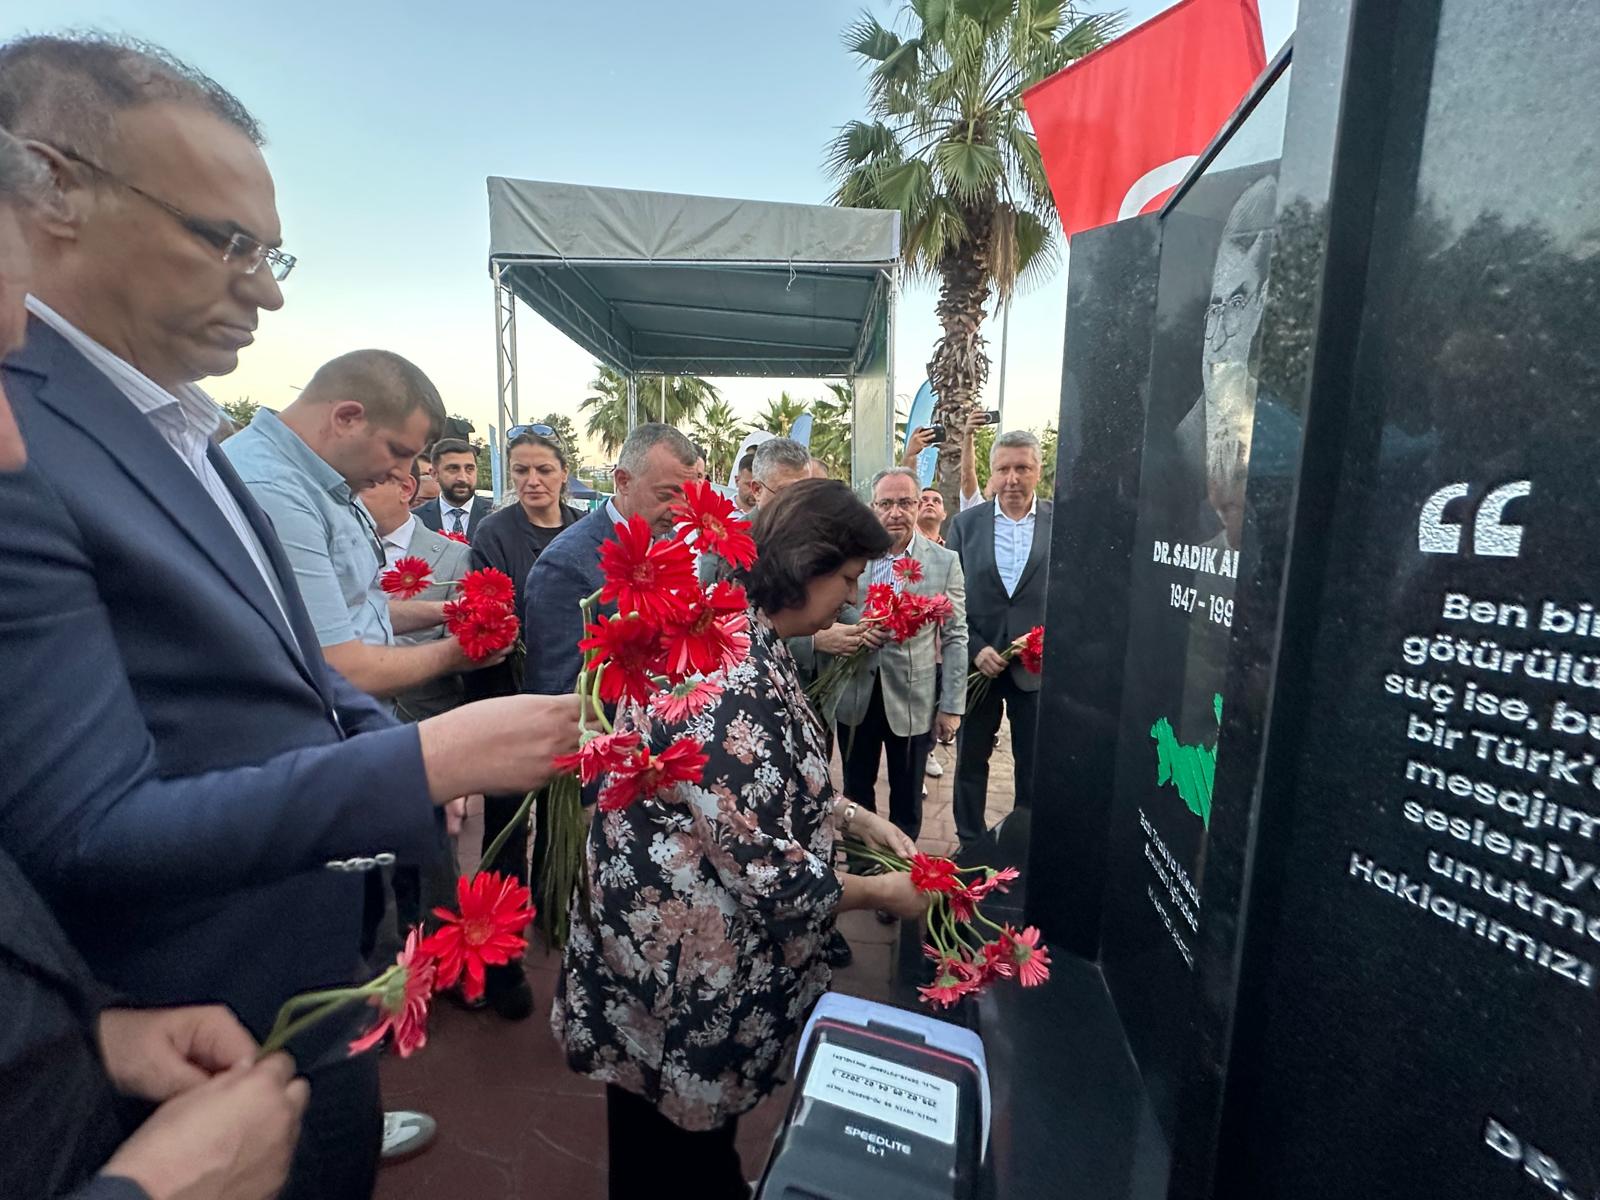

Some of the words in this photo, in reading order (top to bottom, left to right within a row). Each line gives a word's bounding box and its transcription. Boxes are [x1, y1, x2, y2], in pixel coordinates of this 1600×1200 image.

[1173, 543, 1218, 574] SADIK
[1170, 583, 1198, 613] 1947
[1442, 593, 1527, 628] Ben
[1402, 634, 1600, 689] götürülü
[1384, 673, 1454, 713] suç
[1463, 682, 1538, 730] ise,
[1407, 714, 1463, 749] bir
[1350, 852, 1593, 987] Haklarımızı
[844, 1126, 912, 1155] SPEEDLITE
[866, 1144, 885, 1157] EL-1
